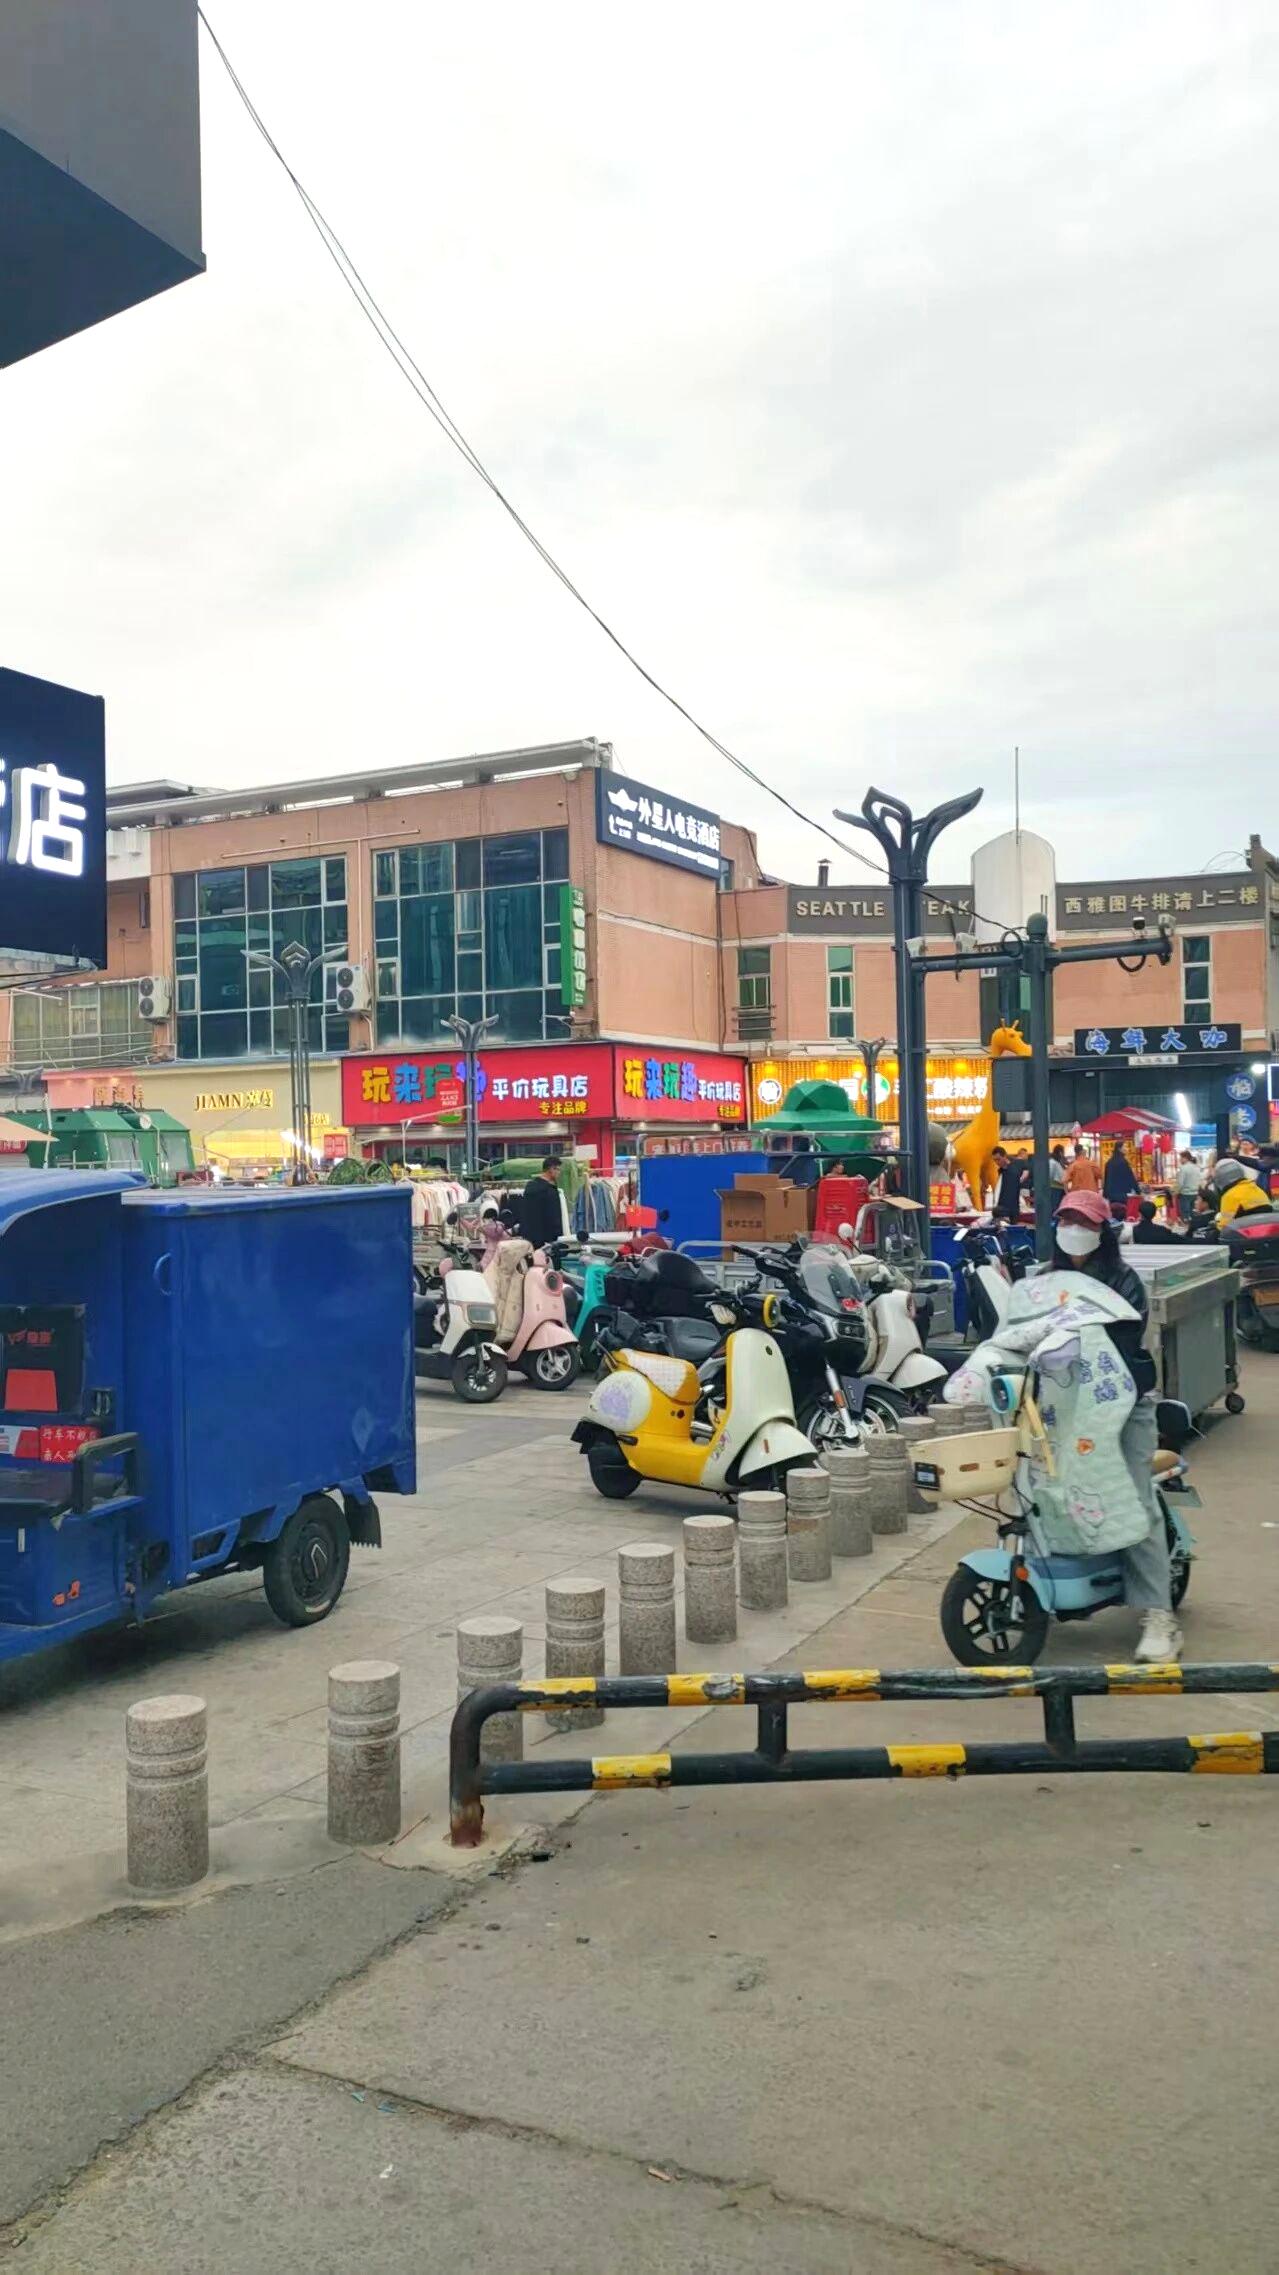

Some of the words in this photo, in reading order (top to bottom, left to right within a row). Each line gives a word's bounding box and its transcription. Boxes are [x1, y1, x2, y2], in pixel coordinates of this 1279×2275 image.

[0, 757, 86, 877] 店
[796, 900, 885, 917] SEATTLE
[1064, 886, 1259, 914] 西雅图牛排请上二楼
[1085, 1026, 1228, 1056] 海鲜大咖
[492, 1074, 588, 1101] 平价玩具店
[698, 1079, 742, 1103] 平价玩具店
[539, 1100, 588, 1116] 专注品牌
